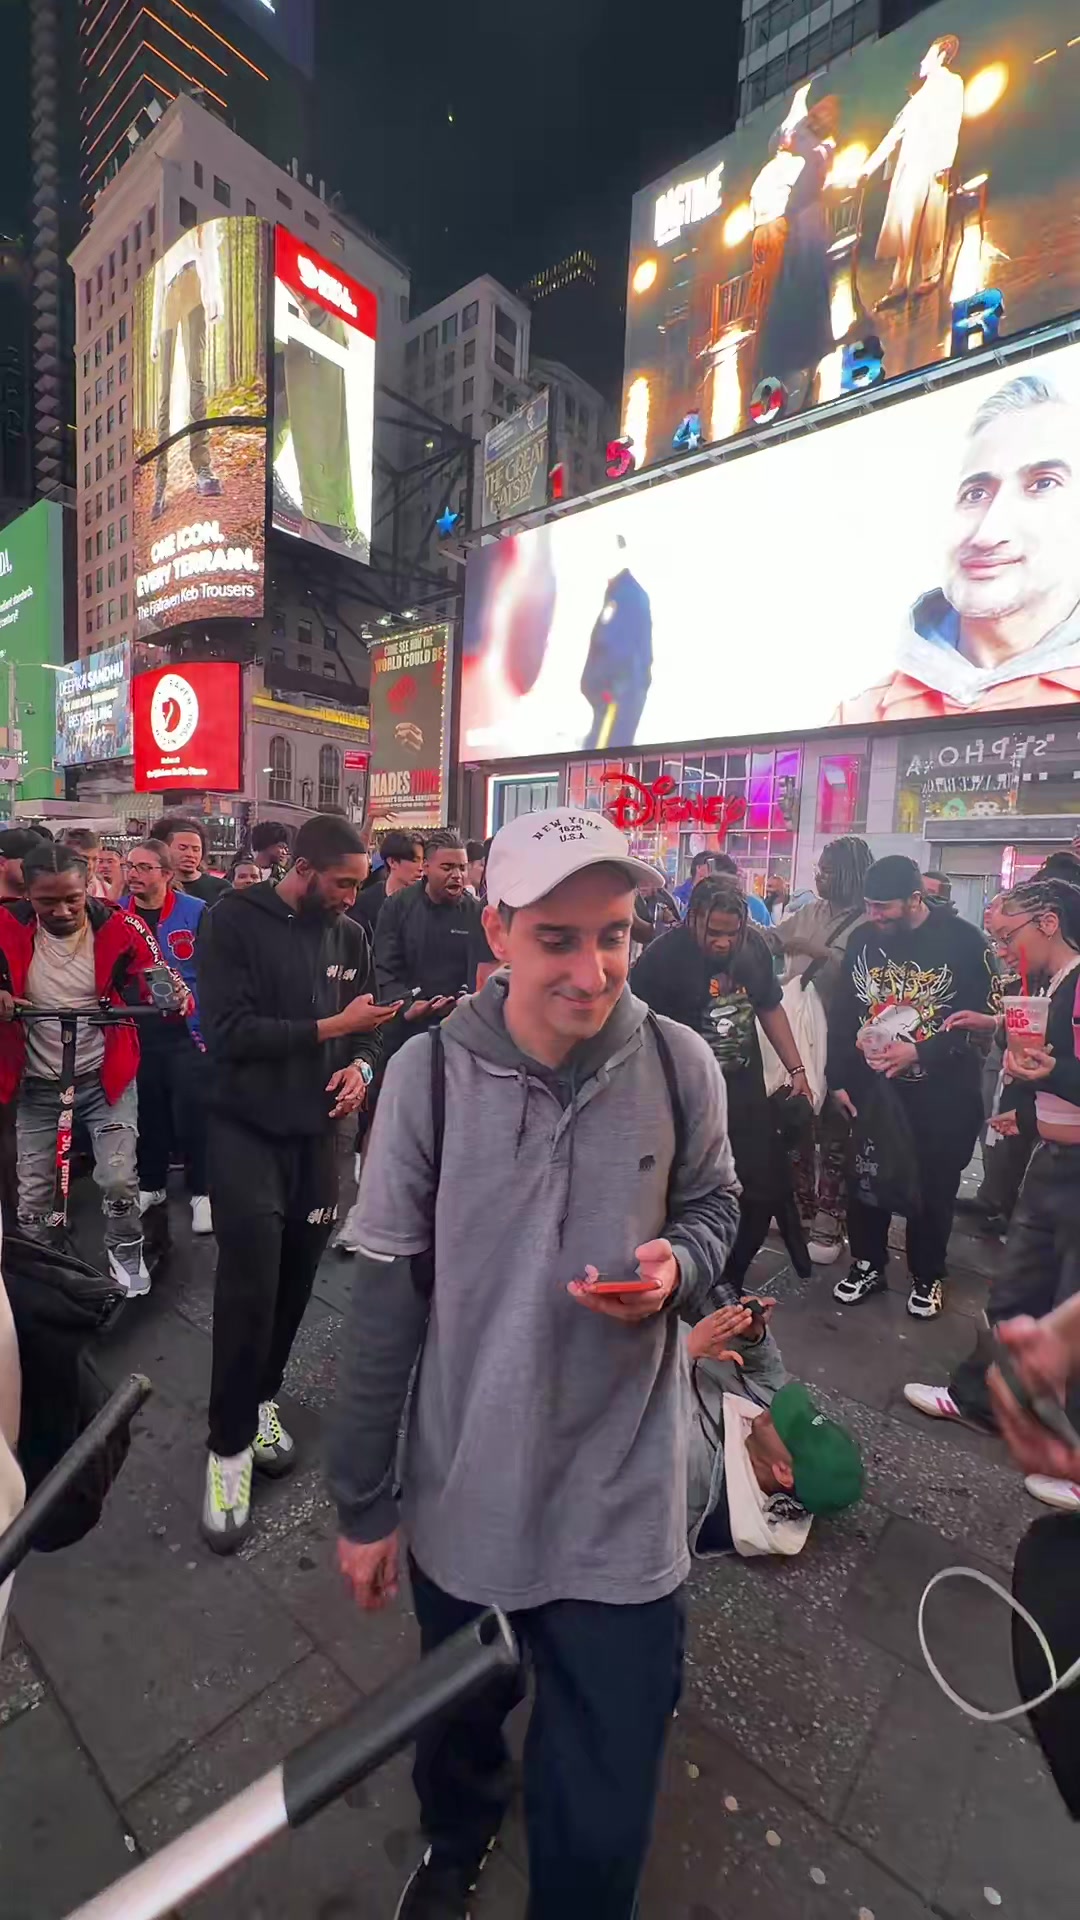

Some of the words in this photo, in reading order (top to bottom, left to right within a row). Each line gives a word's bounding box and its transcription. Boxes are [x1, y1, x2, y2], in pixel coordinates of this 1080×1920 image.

[486, 465, 504, 498] THE
[506, 440, 546, 482] GREAT
[490, 464, 538, 514] GATSBY
[137, 605, 150, 621] The
[180, 585, 199, 602] Keb
[200, 583, 255, 598] Trousers
[374, 655, 402, 675] WORLD
[403, 648, 431, 668] COULD
[431, 646, 444, 663] BE
[398, 640, 410, 654] SEE
[60, 672, 88, 698] DEEPIKA
[87, 661, 123, 690] SANDHU
[532, 819, 562, 841] NEW
[568, 816, 603, 831] YORK
[125, 915, 146, 935] KLEIN
